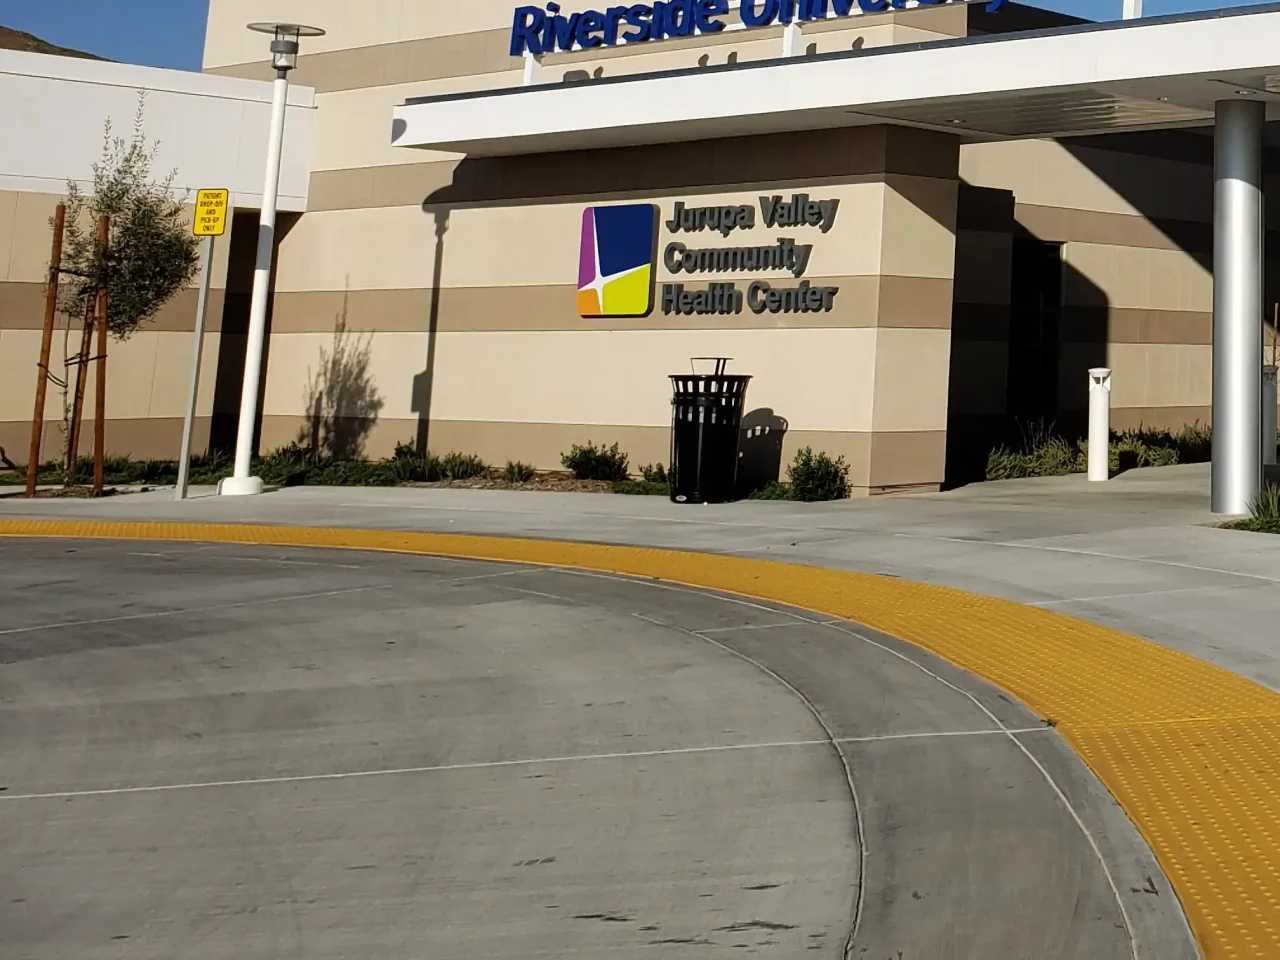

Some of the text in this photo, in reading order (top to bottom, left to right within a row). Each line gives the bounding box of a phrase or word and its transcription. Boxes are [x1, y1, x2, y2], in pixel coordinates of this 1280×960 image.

[665, 193, 840, 238] Jurupa Valley
[663, 237, 813, 278] Community
[661, 279, 839, 316] Health Center
